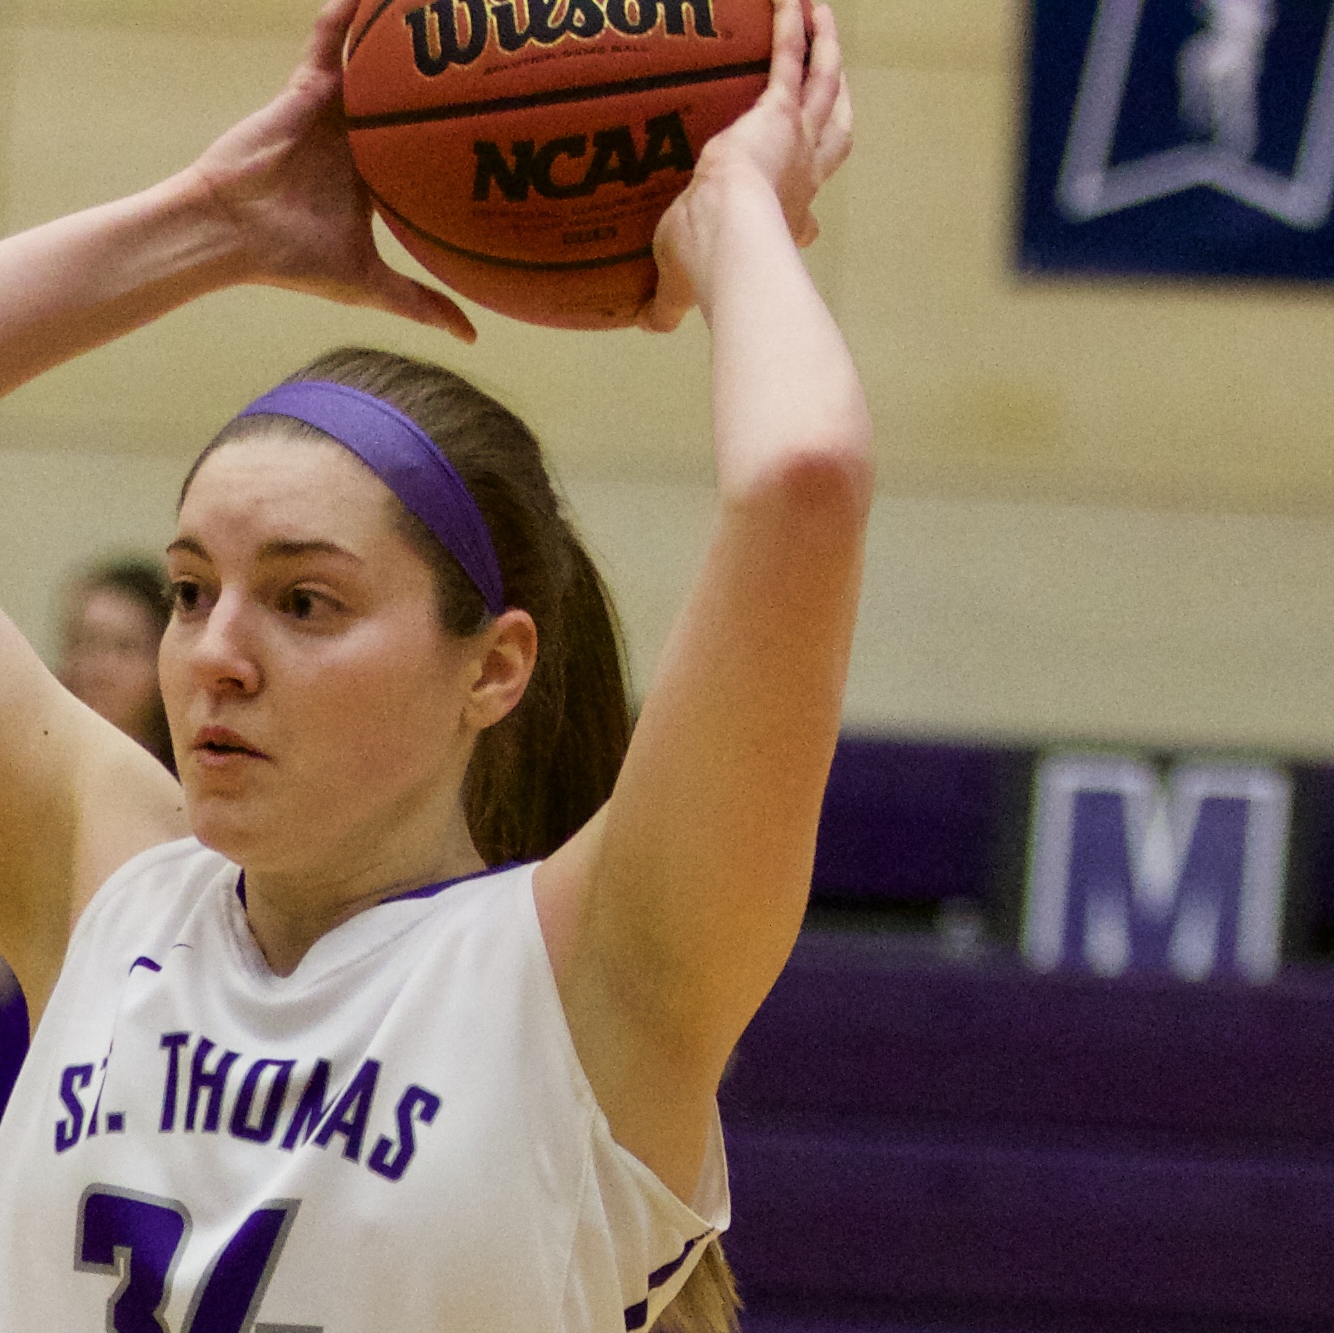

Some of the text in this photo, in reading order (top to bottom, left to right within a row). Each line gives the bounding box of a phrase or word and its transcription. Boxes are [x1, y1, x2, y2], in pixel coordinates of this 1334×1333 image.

[404, 0, 720, 79] Wilson
[471, 110, 694, 202] NCAA
[1023, 757, 1293, 985] M
[54, 1048, 127, 1155] S.
